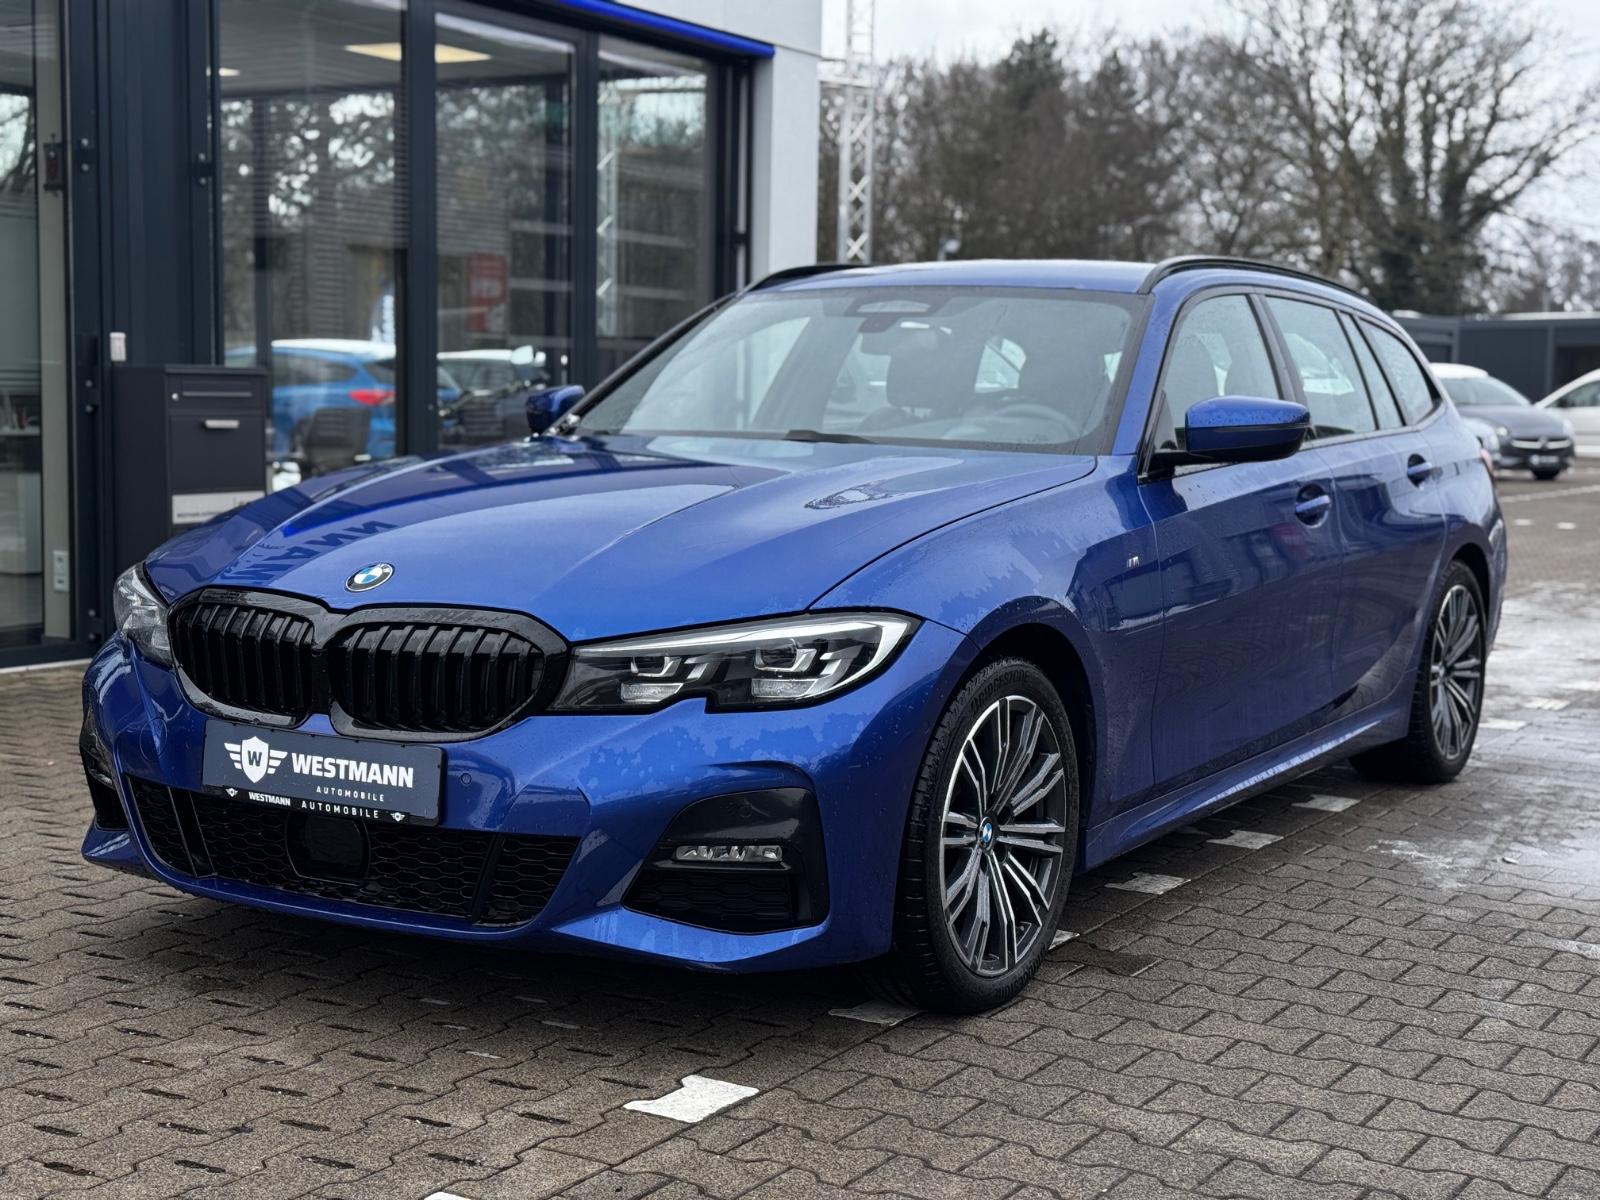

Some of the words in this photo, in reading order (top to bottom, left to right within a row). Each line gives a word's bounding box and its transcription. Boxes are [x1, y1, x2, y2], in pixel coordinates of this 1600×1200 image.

[247, 750, 263, 767] W
[292, 753, 414, 789] WESTMANN
[249, 791, 291, 806] WESTMANN
[301, 801, 380, 820] AUTOMOBILE
[316, 786, 385, 803] AUTOMOBILE
